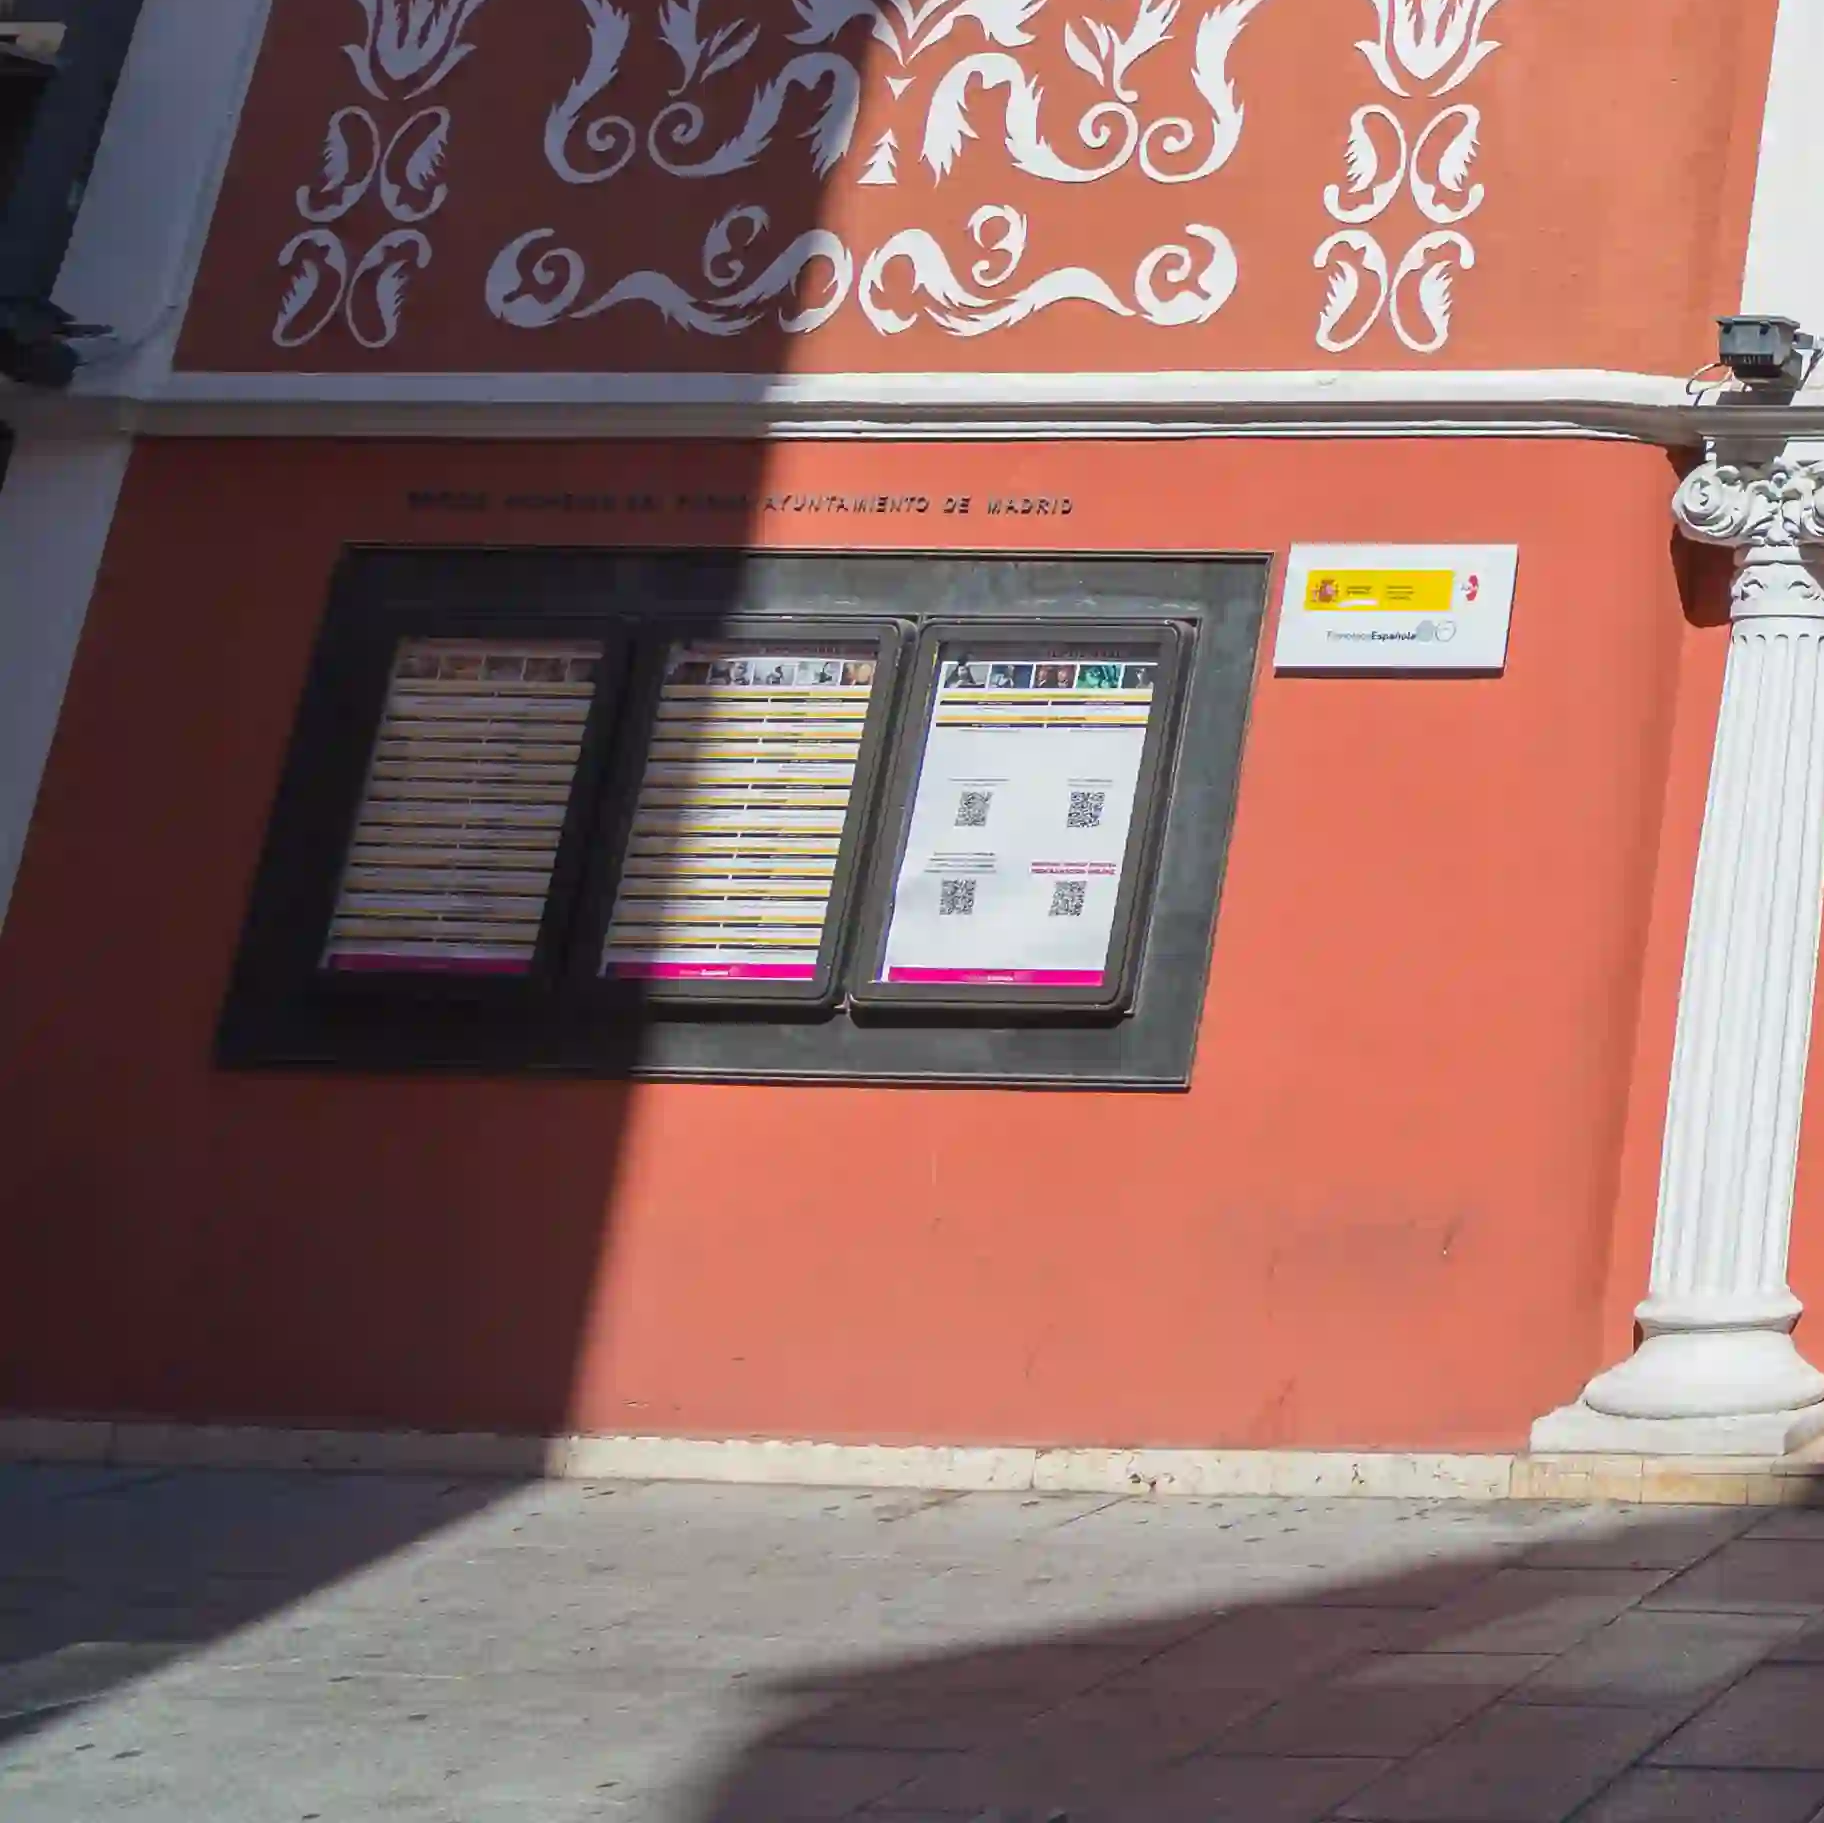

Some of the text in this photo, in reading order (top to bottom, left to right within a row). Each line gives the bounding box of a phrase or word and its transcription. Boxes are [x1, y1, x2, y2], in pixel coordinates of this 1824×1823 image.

[763, 493, 930, 514] AYUNTAMIENTO
[942, 495, 972, 514] DE
[986, 495, 1073, 515] MADRID
